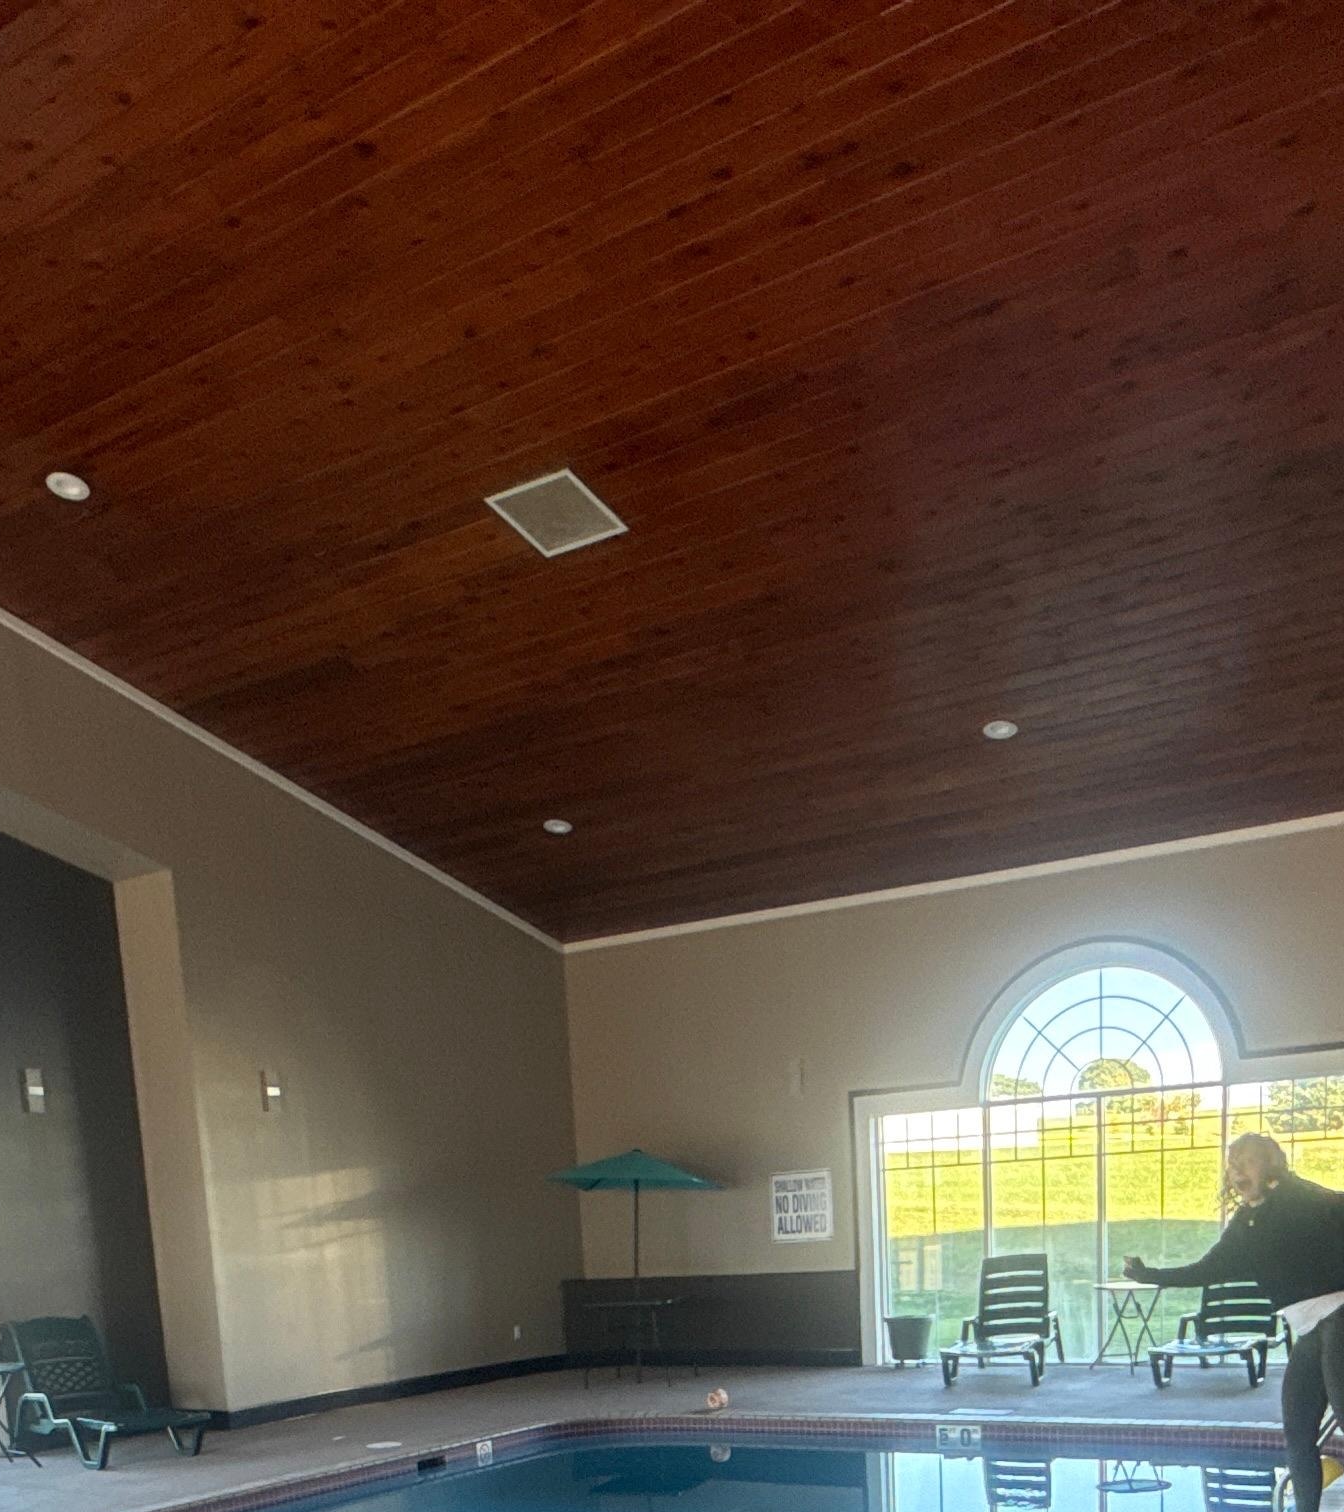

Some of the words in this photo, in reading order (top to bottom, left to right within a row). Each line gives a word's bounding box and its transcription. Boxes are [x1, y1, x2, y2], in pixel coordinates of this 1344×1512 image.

[775, 1194, 790, 1215] NO
[791, 1191, 827, 1214] DIVING
[777, 1213, 827, 1235] ALLOWED
[959, 1428, 972, 1448] 0
